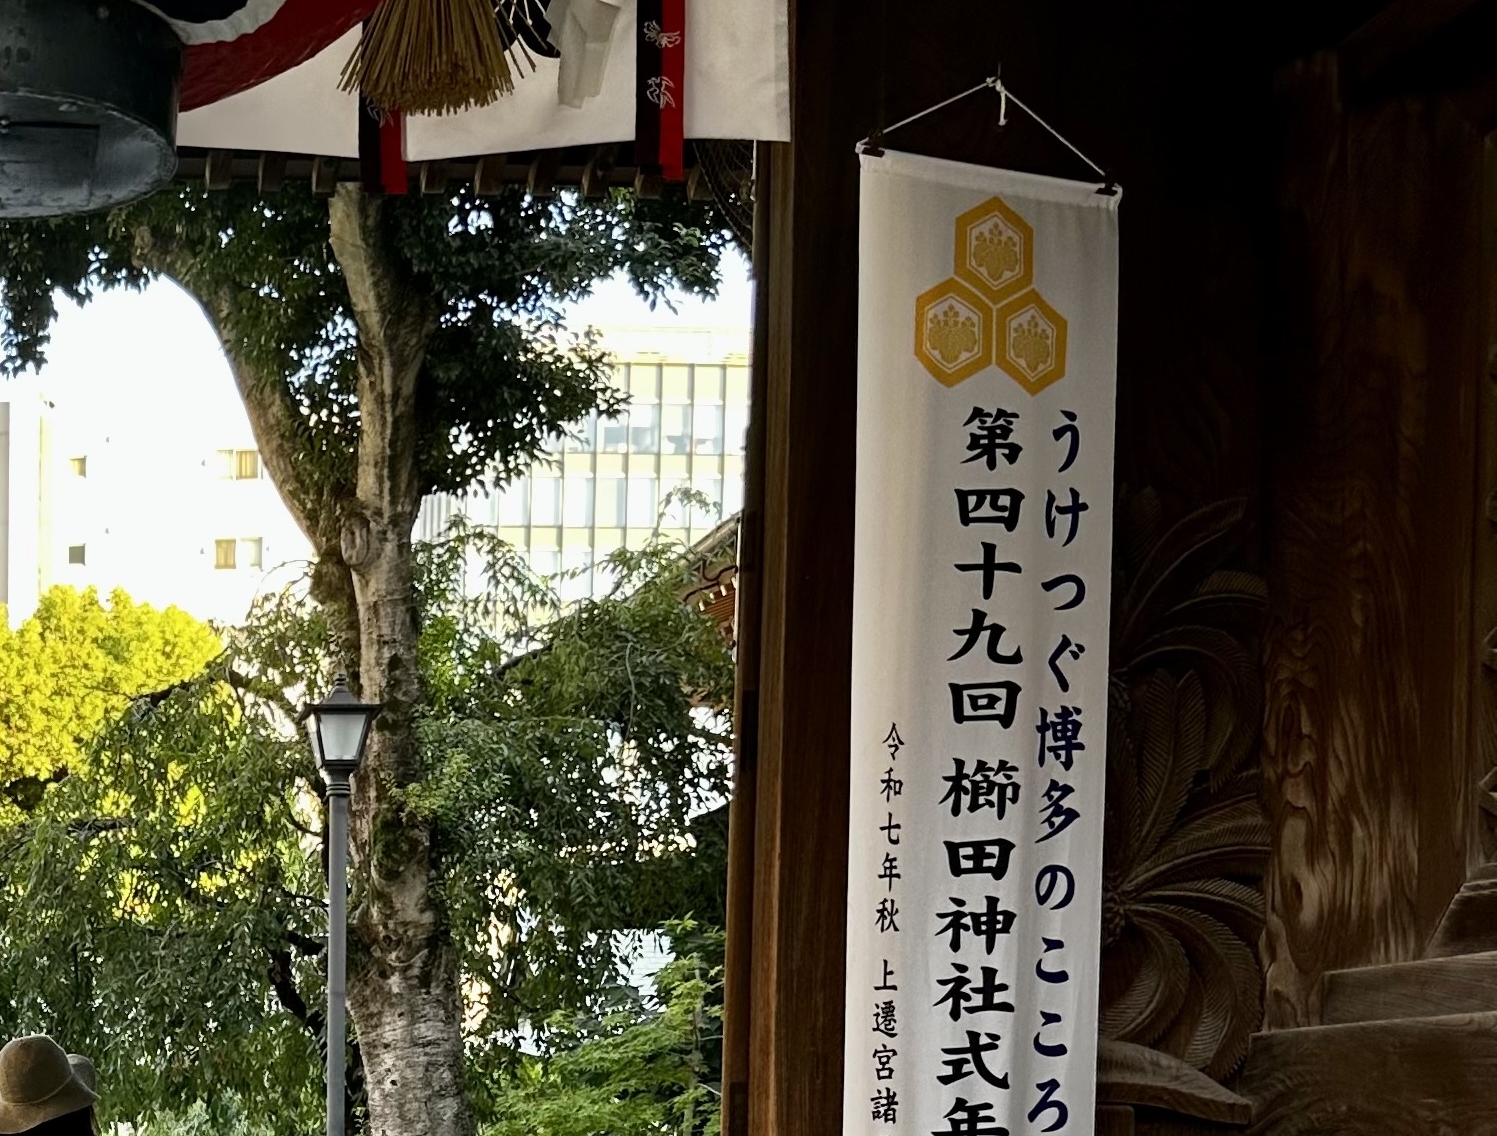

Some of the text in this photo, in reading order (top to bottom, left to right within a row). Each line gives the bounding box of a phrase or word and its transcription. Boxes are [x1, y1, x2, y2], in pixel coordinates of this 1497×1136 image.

[874, 722, 905, 934] 令和七年秋
[1027, 410, 1089, 1133] うけつぐ博多のこころ
